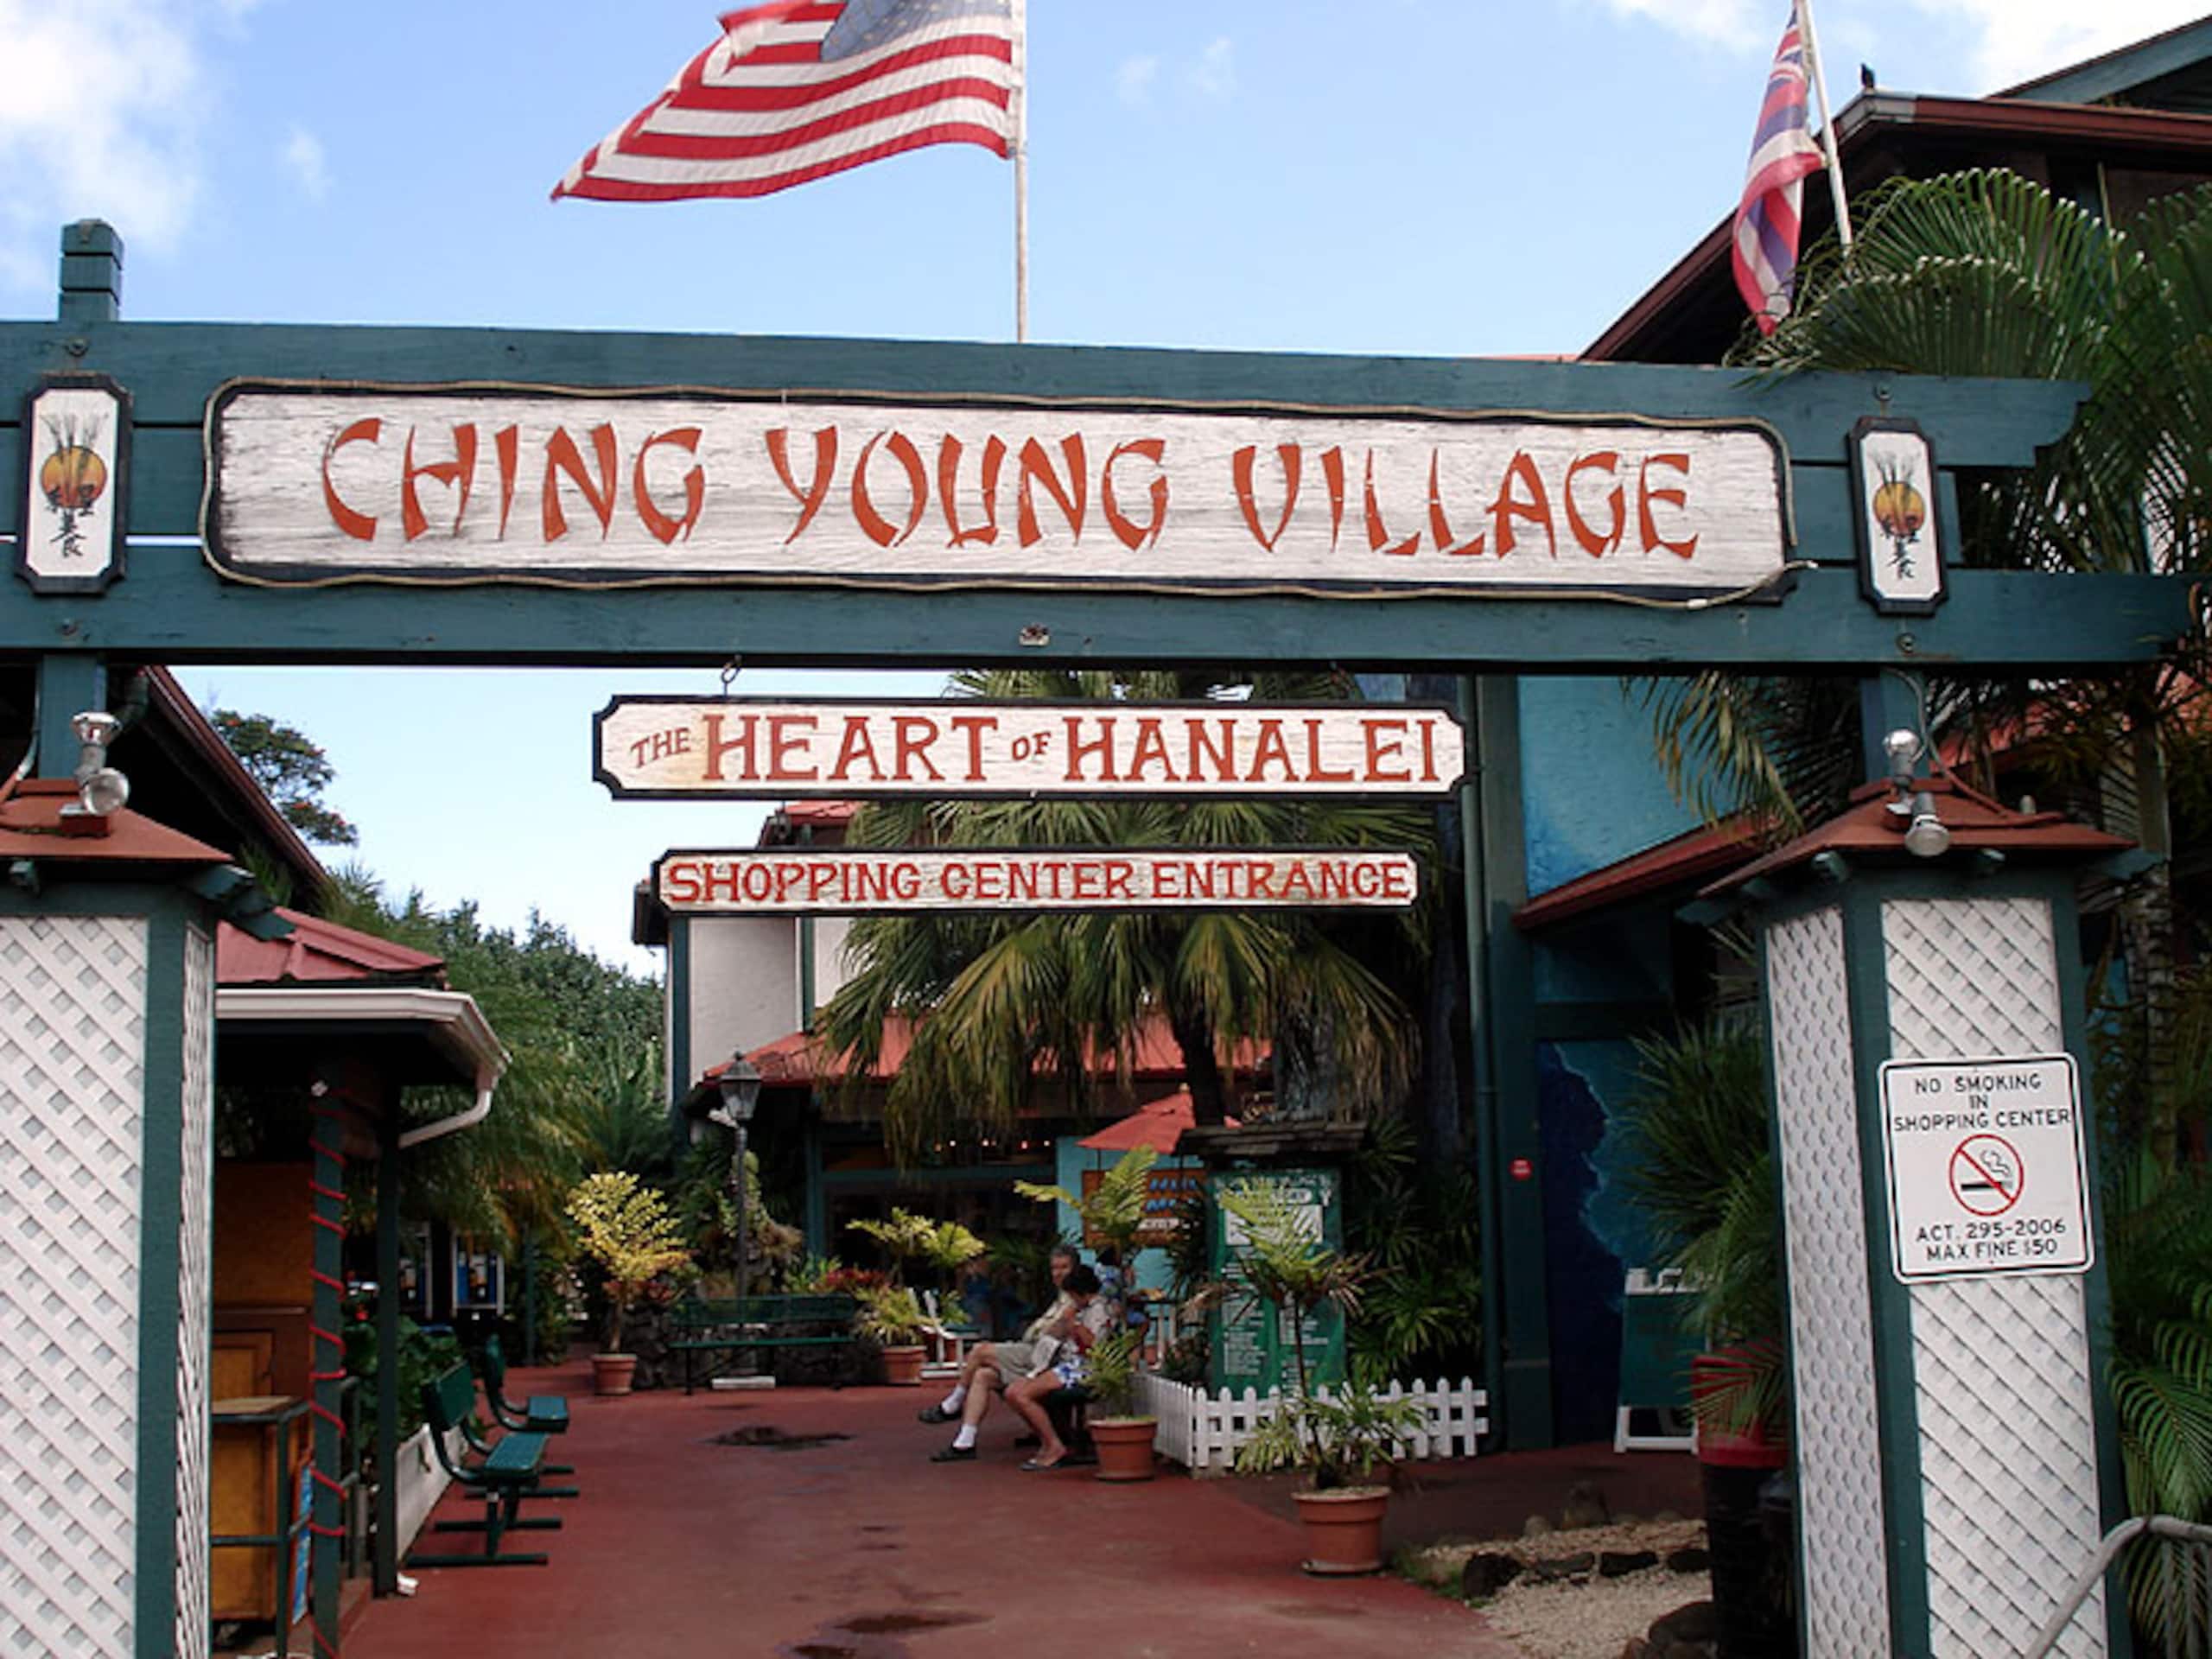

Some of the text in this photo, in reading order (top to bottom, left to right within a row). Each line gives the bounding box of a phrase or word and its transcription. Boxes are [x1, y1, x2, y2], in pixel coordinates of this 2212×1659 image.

[322, 417, 1699, 559] CHING YOUNG VILLAGE
[630, 714, 1440, 782] THE HEART OF HANALEI
[667, 861, 1410, 903] SHOPPING CENTER ENTRANCE
[1915, 1073, 2042, 1095] NO SMOKING
[1969, 1095, 1988, 1109] IN
[1893, 1109, 2071, 1131] SHOPPING CENTER
[1967, 1218, 2066, 1240] 295-2006
[1926, 1244, 1968, 1261] MAX
[1976, 1241, 2020, 1258] FINE
